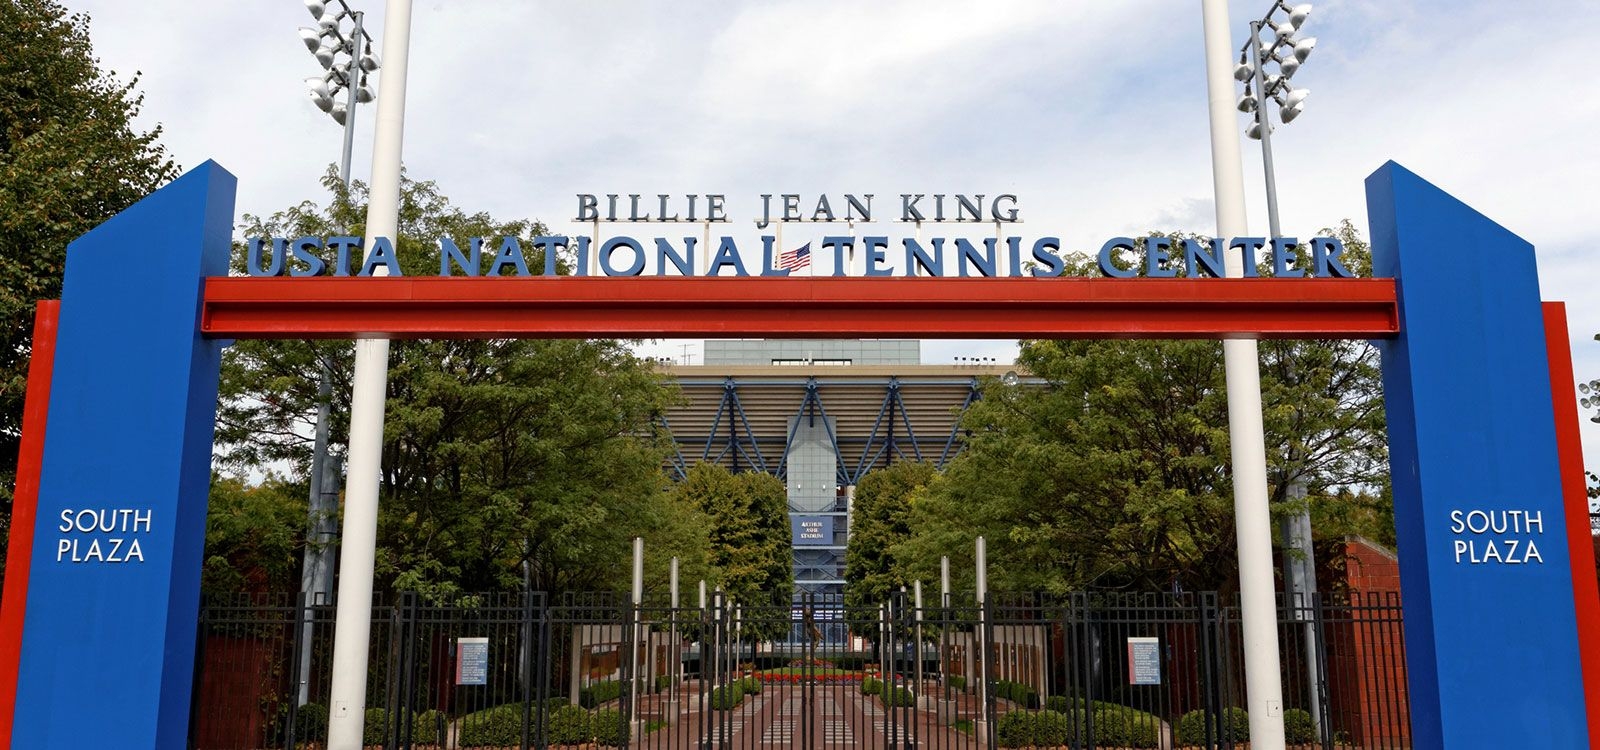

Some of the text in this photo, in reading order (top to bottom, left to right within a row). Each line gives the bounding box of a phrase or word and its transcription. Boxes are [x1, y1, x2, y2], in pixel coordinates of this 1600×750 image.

[575, 193, 1020, 228] BILLIE JEAN KING
[247, 236, 1355, 277] USTA NATIONAL TENNIS CENTER
[59, 508, 152, 533] SOUTH
[1450, 509, 1543, 534] SOUTH
[57, 538, 145, 562] PLAZA
[1454, 539, 1543, 563] PLAZA
